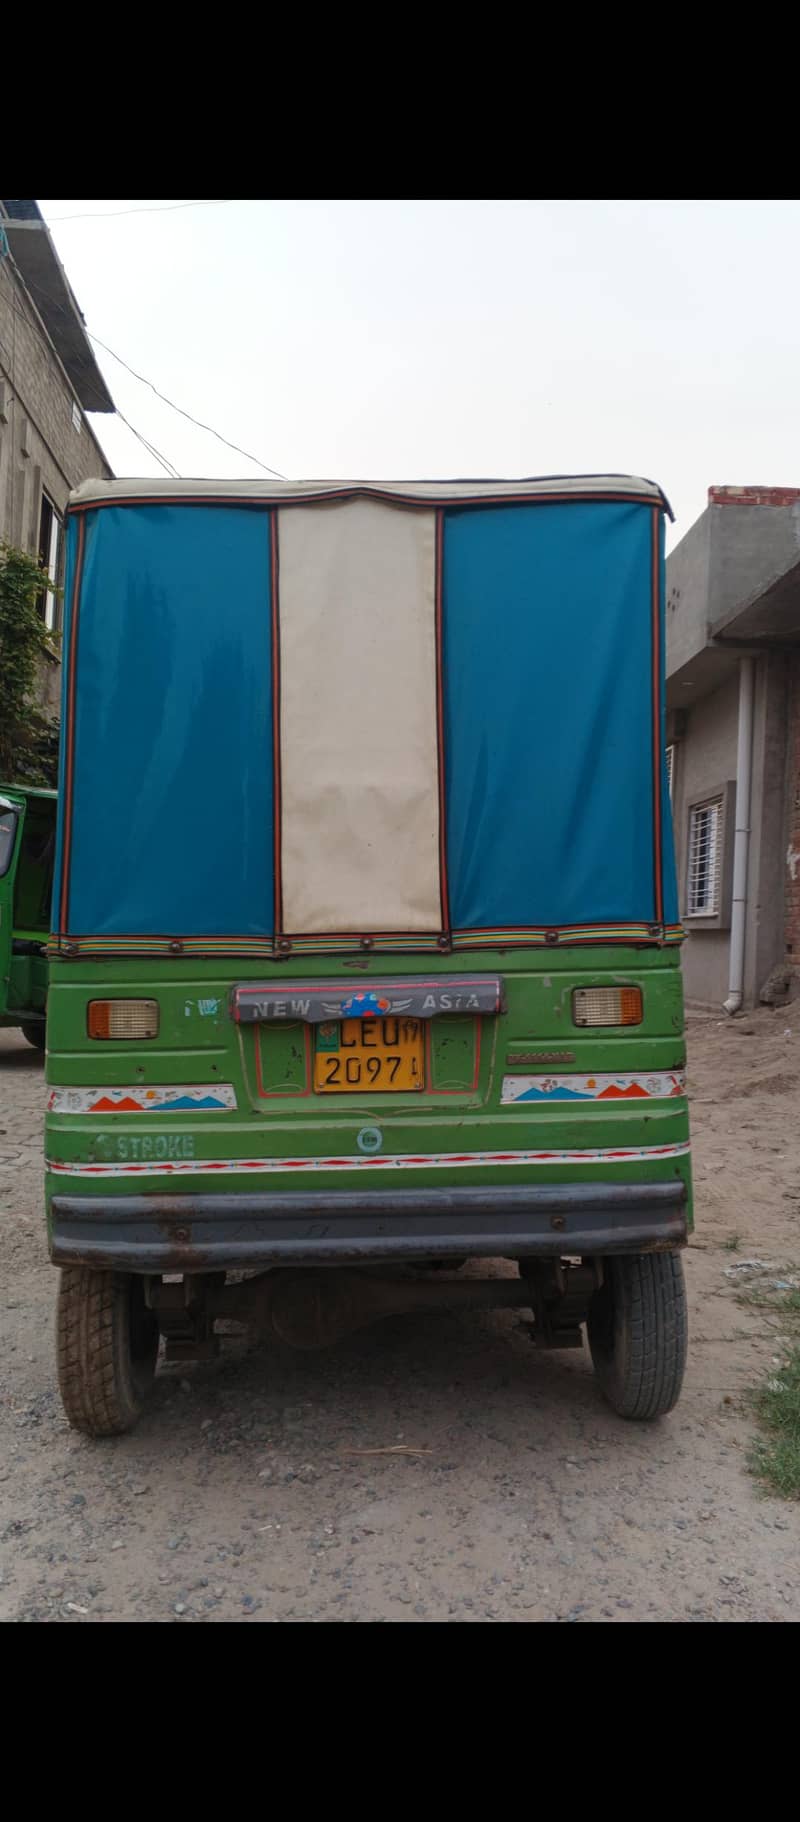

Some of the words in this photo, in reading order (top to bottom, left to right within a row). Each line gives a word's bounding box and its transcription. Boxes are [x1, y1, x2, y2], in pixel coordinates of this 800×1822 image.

[253, 1000, 310, 1017] NEW
[340, 1018, 399, 1047] LEU
[326, 1056, 401, 1084] 2097
[117, 1135, 194, 1158] STROKE
